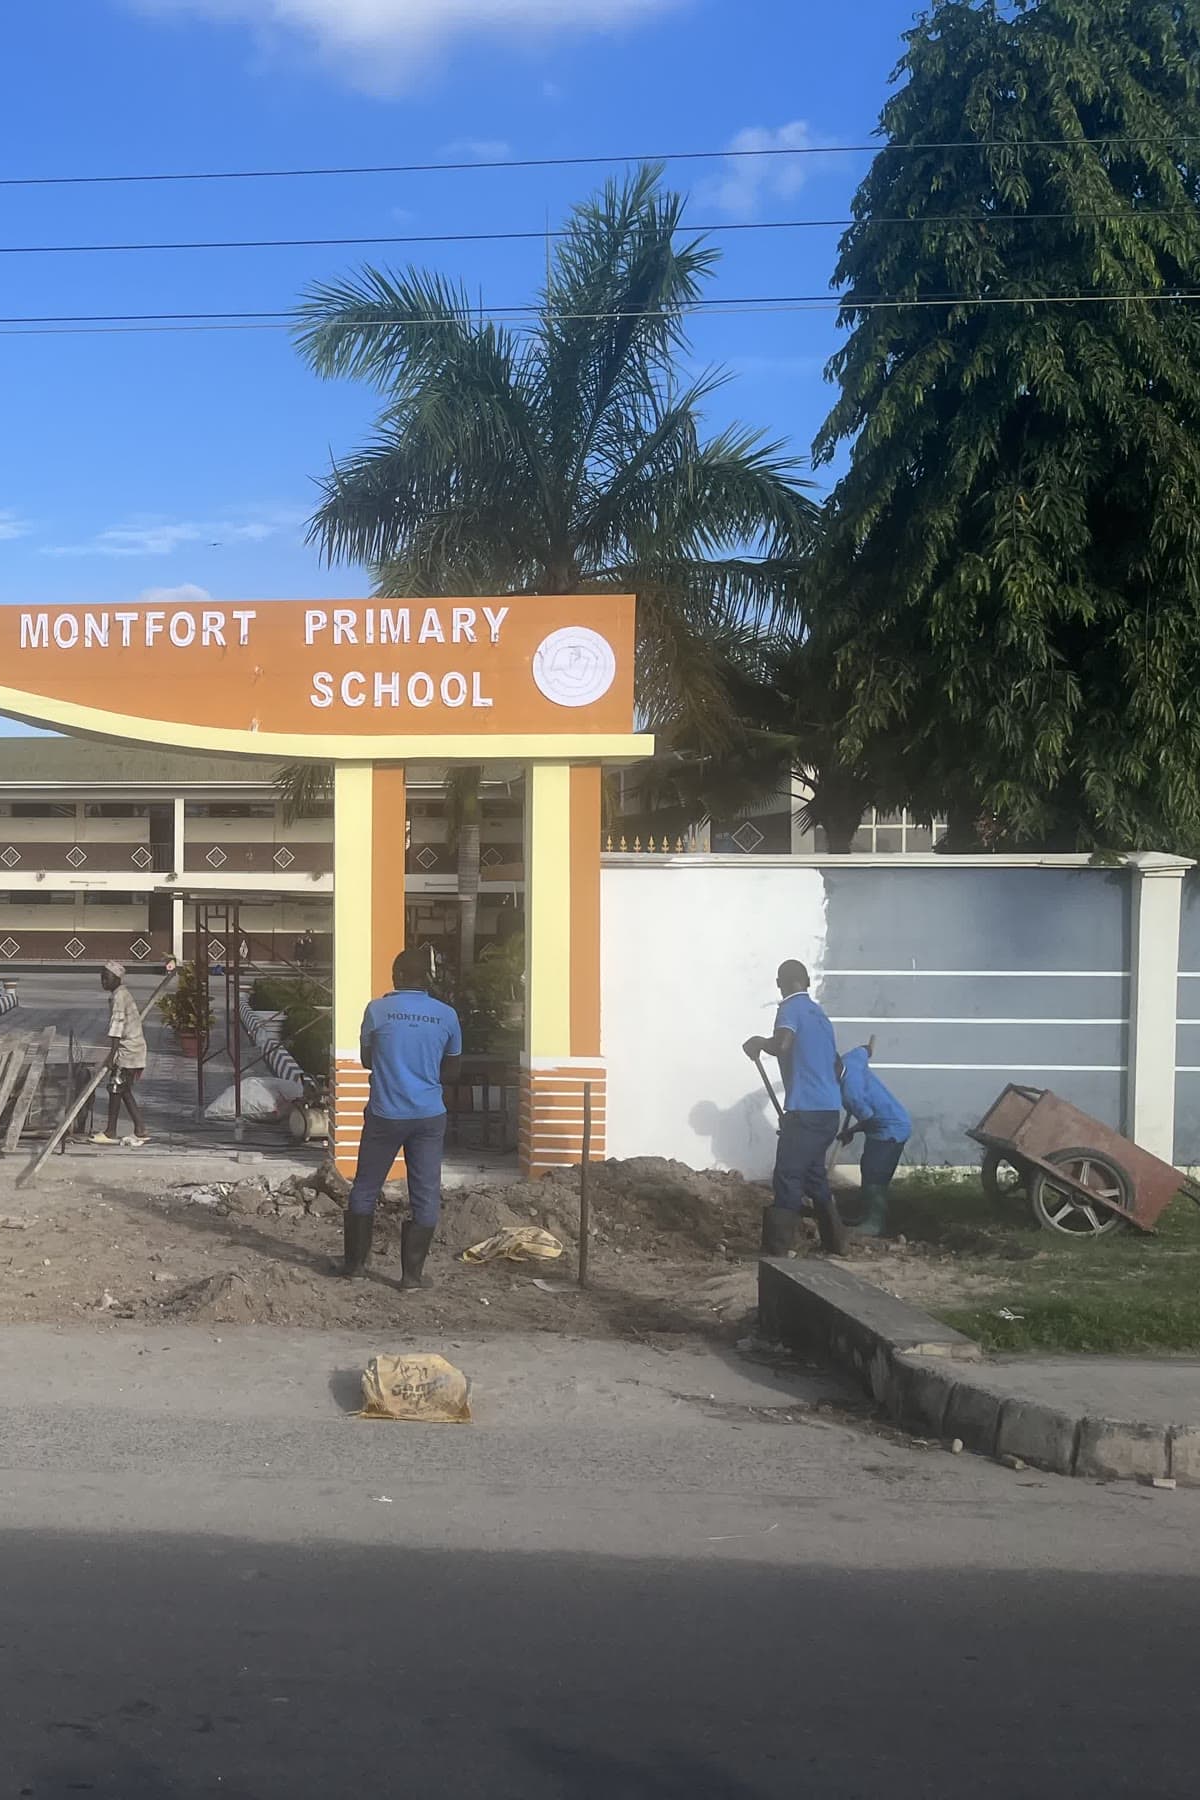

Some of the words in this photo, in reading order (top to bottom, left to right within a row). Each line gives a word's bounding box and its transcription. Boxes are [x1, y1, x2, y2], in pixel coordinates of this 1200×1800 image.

[20, 611, 257, 648] MONTFORT
[304, 607, 509, 645] PRIMARY
[310, 671, 494, 707] SCHOOL
[387, 1012, 440, 1024] MONTFORT
